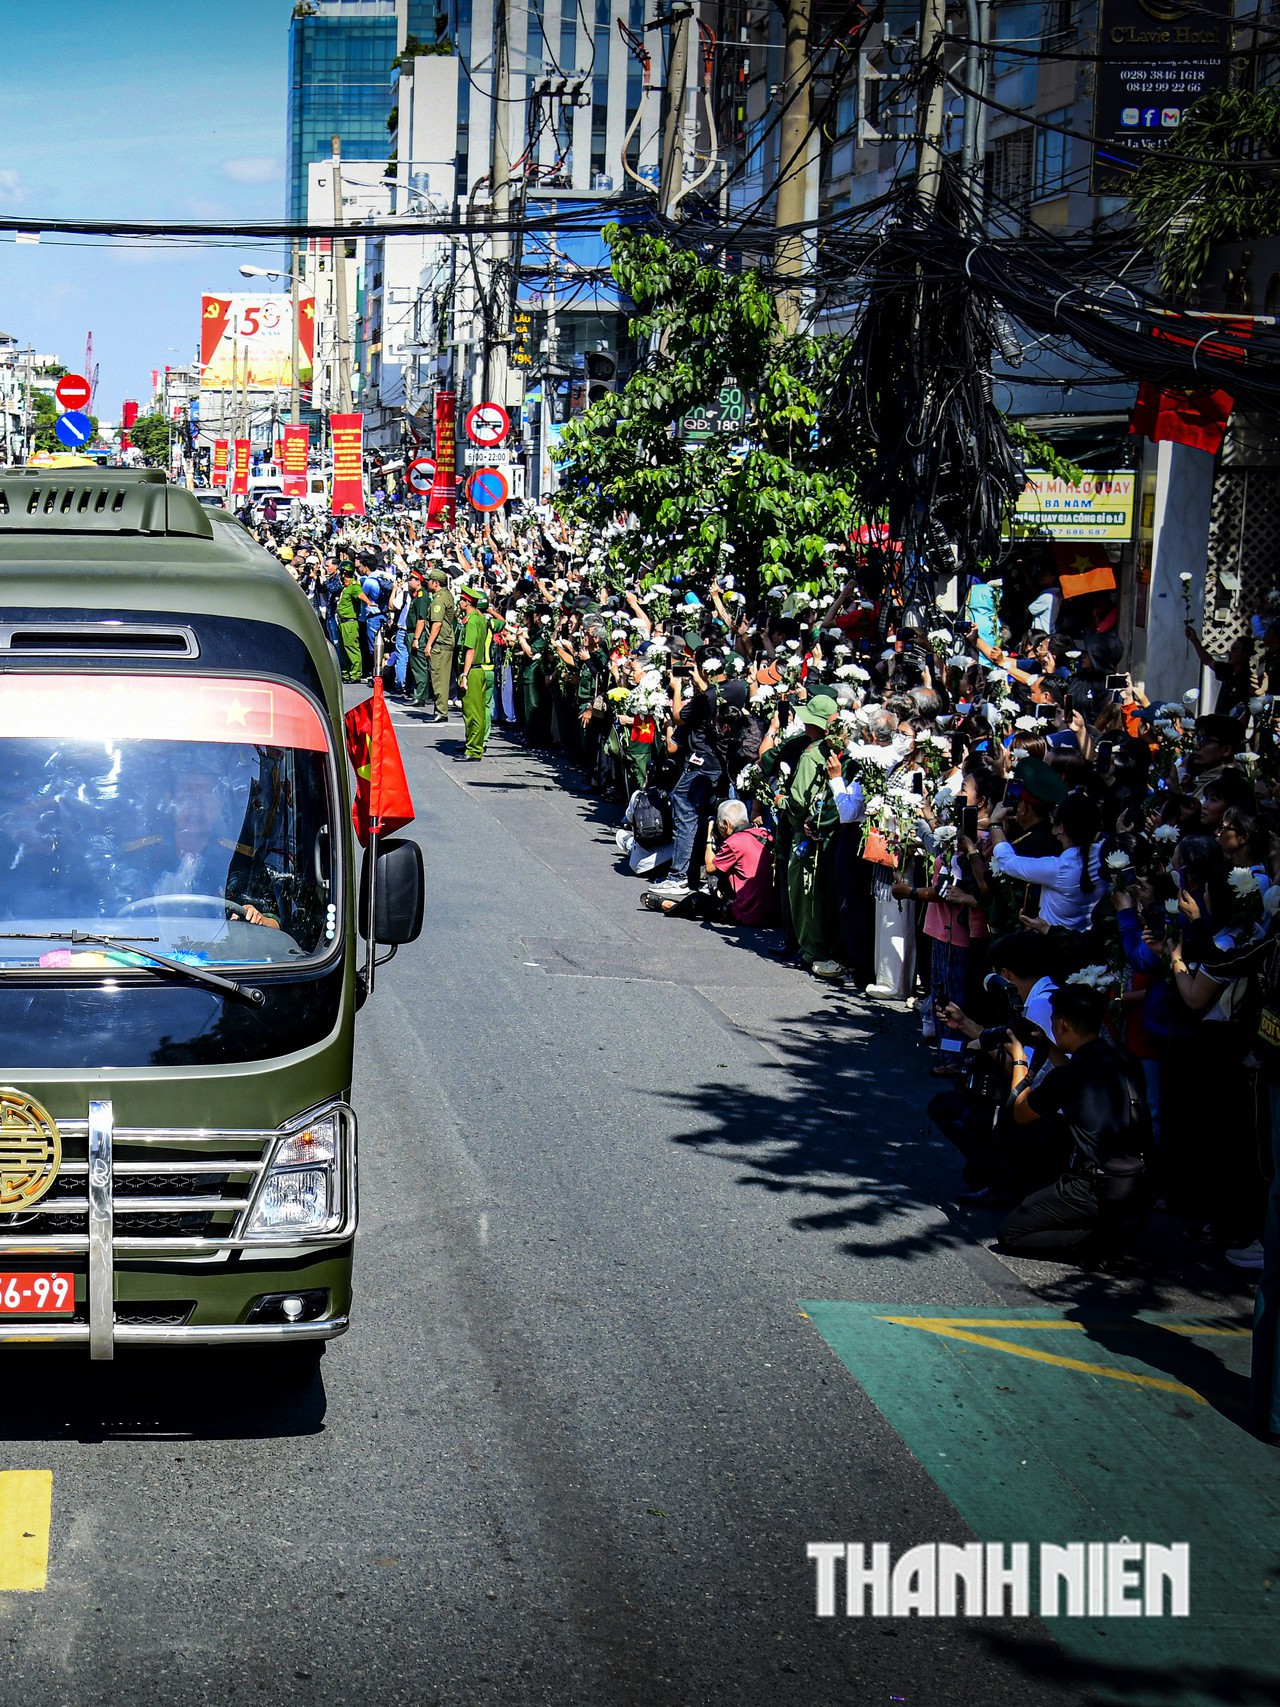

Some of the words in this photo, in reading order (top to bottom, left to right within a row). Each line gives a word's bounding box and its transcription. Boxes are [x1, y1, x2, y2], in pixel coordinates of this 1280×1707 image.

[1174, 26, 1220, 43] Hotel
[1120, 71, 1147, 80] (028)
[1150, 71, 1176, 80] 3846
[1180, 71, 1205, 80] 1618
[1126, 83, 1153, 92] 0842
[1155, 83, 1169, 92] 99
[1172, 83, 1185, 92] 22
[1187, 83, 1201, 92] 66
[720, 405, 742, 420] 70
[1095, 481, 1130, 495] QUAY
[1035, 513, 1058, 523] QUAY
[1058, 513, 1072, 523] GIA
[1073, 512, 1096, 523] CÔNG
